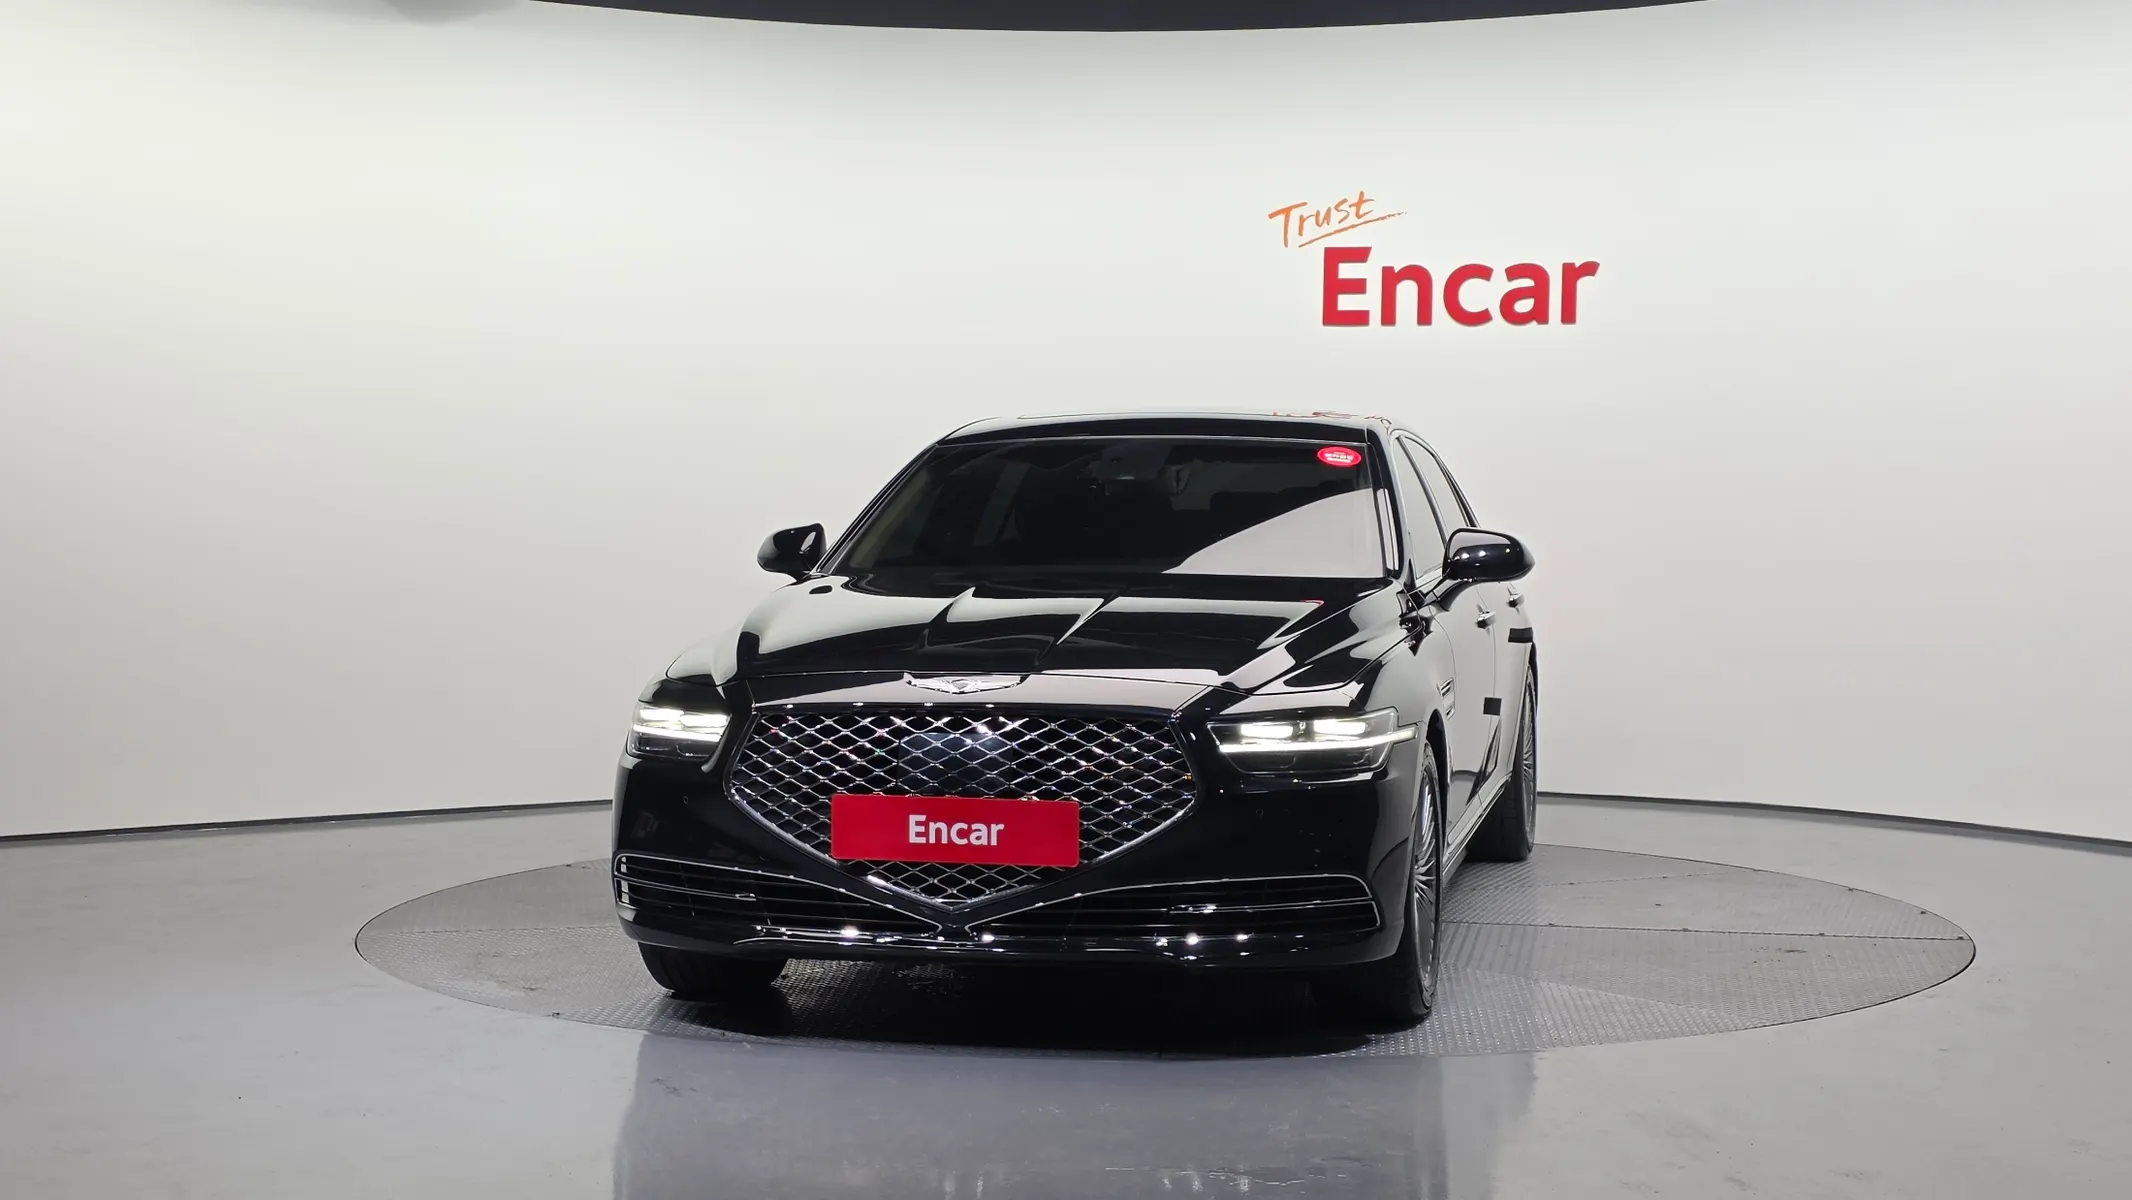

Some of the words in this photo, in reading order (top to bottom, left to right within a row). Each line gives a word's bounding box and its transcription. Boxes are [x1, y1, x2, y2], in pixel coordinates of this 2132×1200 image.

[1268, 191, 1375, 248] Trust
[1322, 247, 1600, 326] Encar
[908, 814, 1005, 846] Encar
